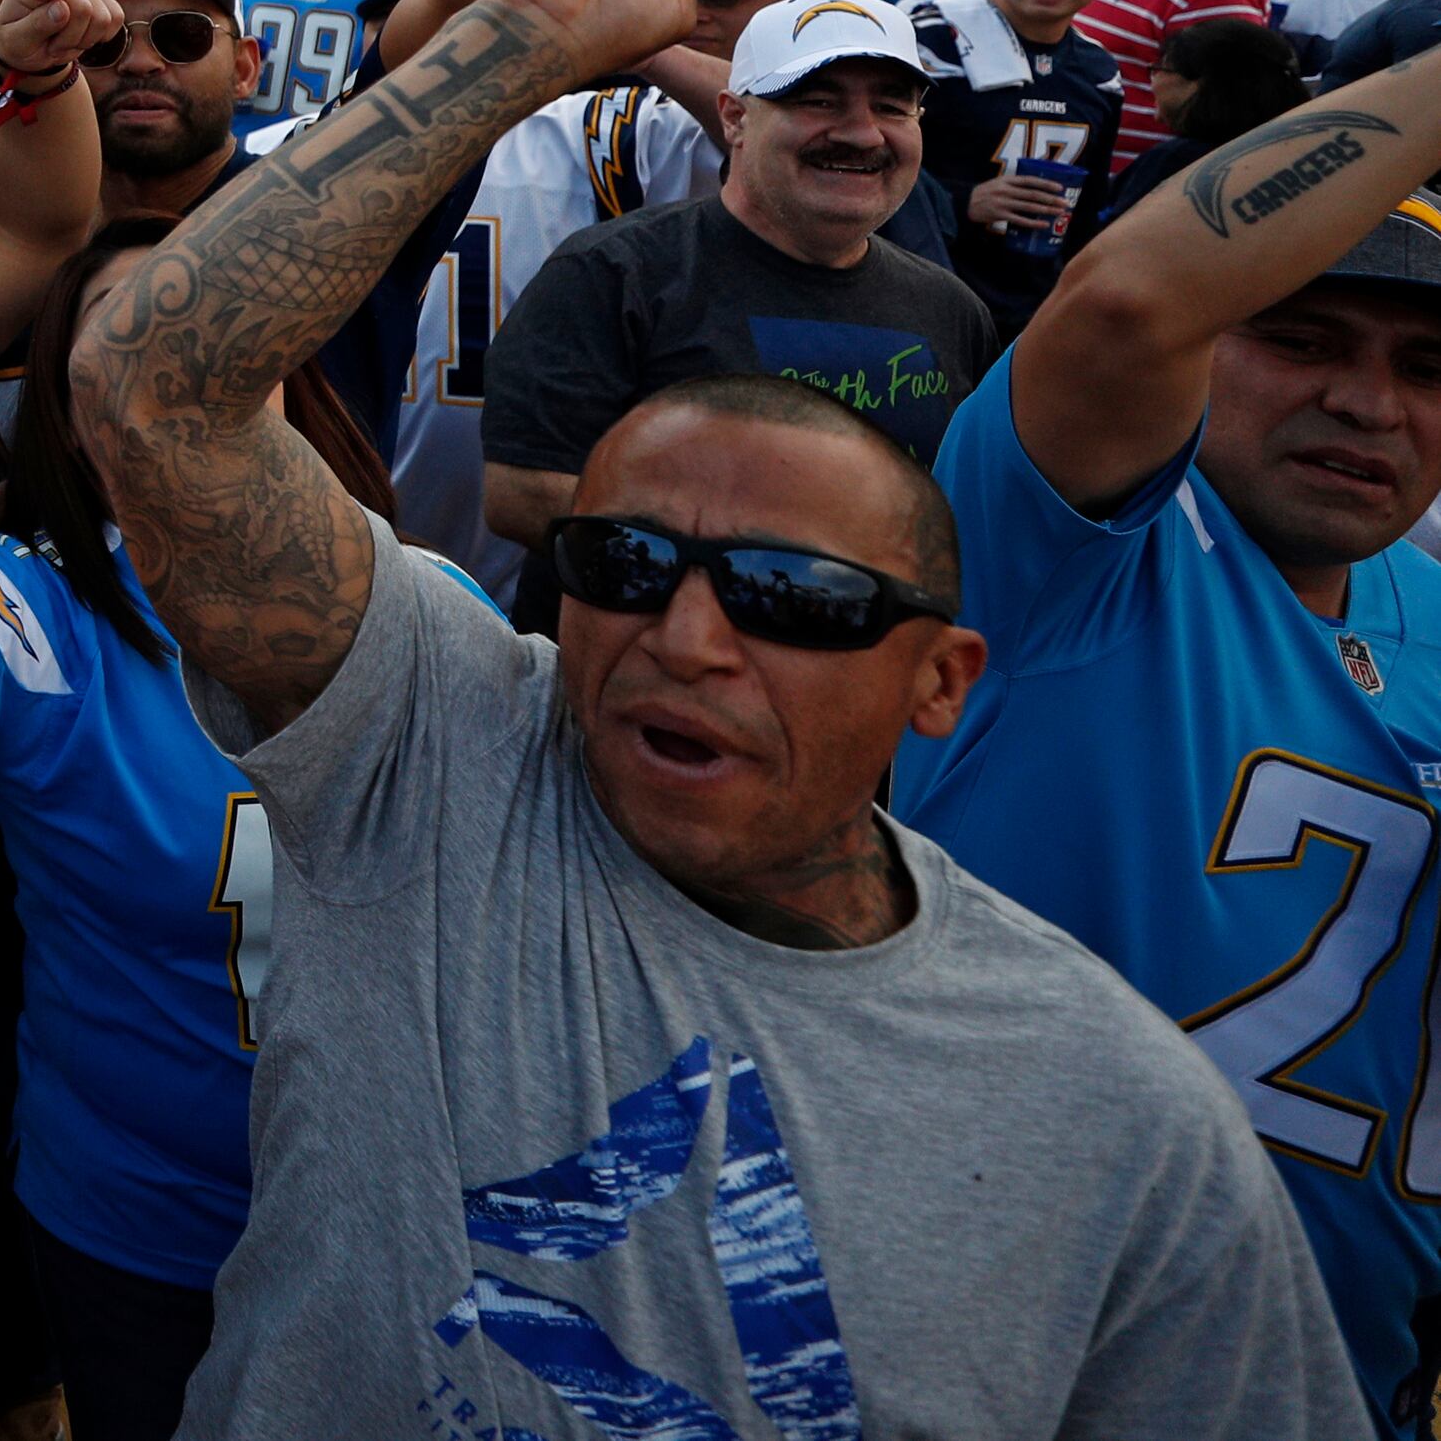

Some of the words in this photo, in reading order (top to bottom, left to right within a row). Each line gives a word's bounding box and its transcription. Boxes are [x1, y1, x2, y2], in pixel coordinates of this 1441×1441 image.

[1019, 98, 1068, 115] CHARGERS
[1230, 131, 1366, 226] CHARGERS
[885, 344, 950, 401] Face
[1344, 657, 1379, 685] NFL
